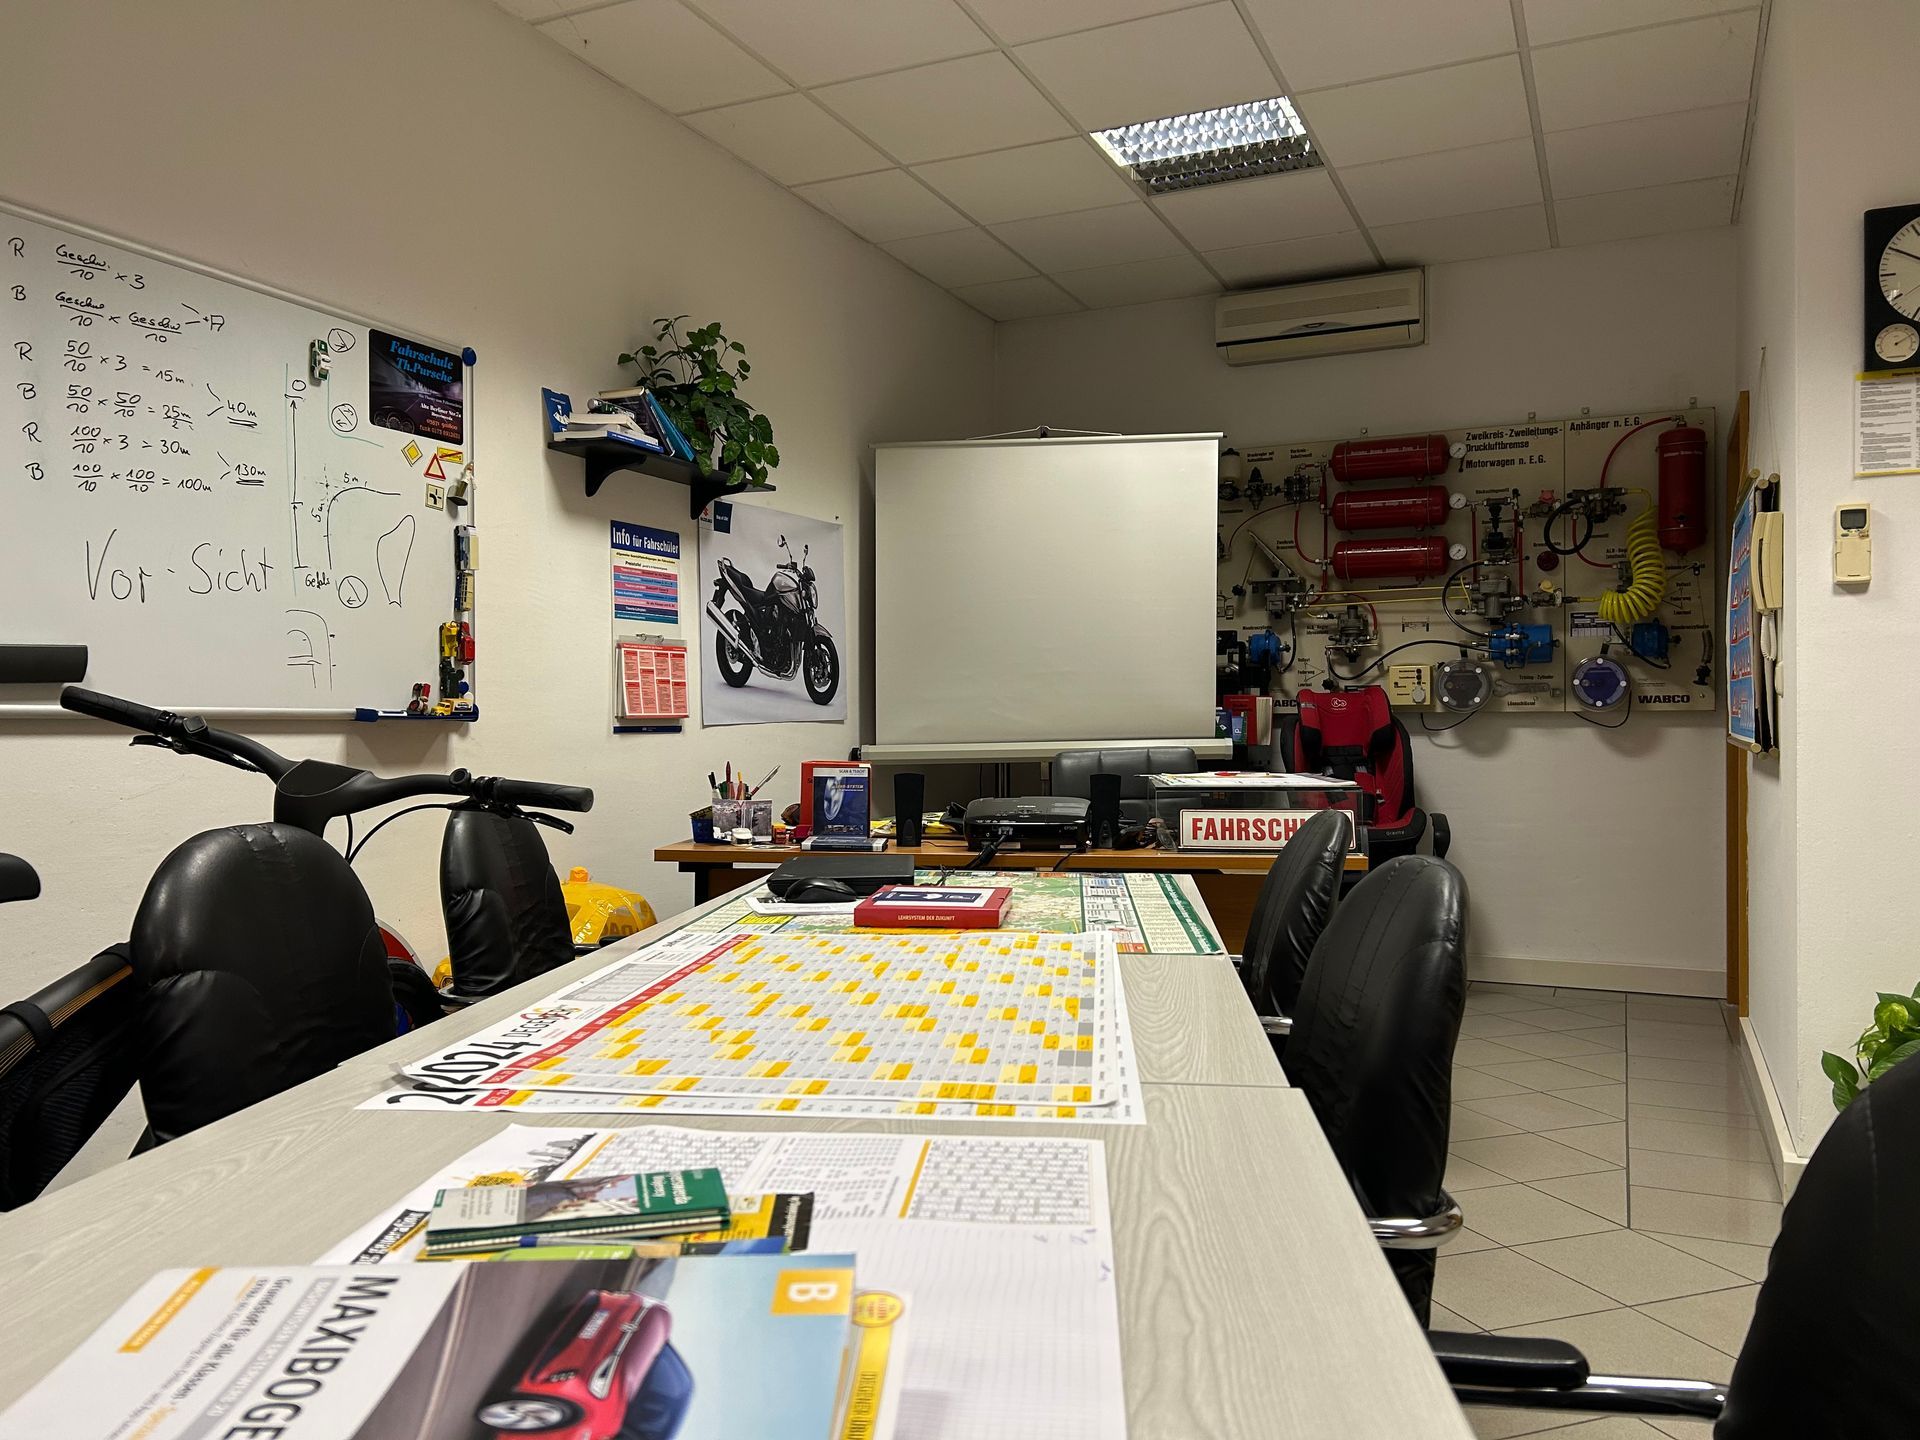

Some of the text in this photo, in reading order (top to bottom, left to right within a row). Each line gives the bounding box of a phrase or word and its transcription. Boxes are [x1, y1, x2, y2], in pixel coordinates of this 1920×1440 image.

[8, 237, 25, 258] R
[129, 274, 146, 290] 3
[11, 285, 27, 301] B
[14, 341, 33, 361] R
[67, 339, 90, 356] 50
[114, 354, 128, 371] 3
[389, 340, 454, 370] Fahrschule
[17, 382, 37, 400] B
[67, 384, 93, 398] 50
[114, 391, 141, 405] 50
[22, 421, 42, 443] R
[1569, 420, 1610, 432] Anhänger
[70, 425, 102, 438] 100
[117, 434, 129, 451] 3
[25, 463, 44, 481] B
[72, 463, 101, 474] 100
[126, 469, 155, 480] 100
[1466, 458, 1515, 469] Motorwagen
[613, 527, 679, 554] Info für Fahrschüler
[1638, 694, 1691, 704] WABCO
[1192, 817, 1306, 841] FAHRSCH
[409, 1041, 542, 1085] 2024
[788, 1281, 839, 1303] B
[222, 1276, 399, 1440] MAXIBOGE
